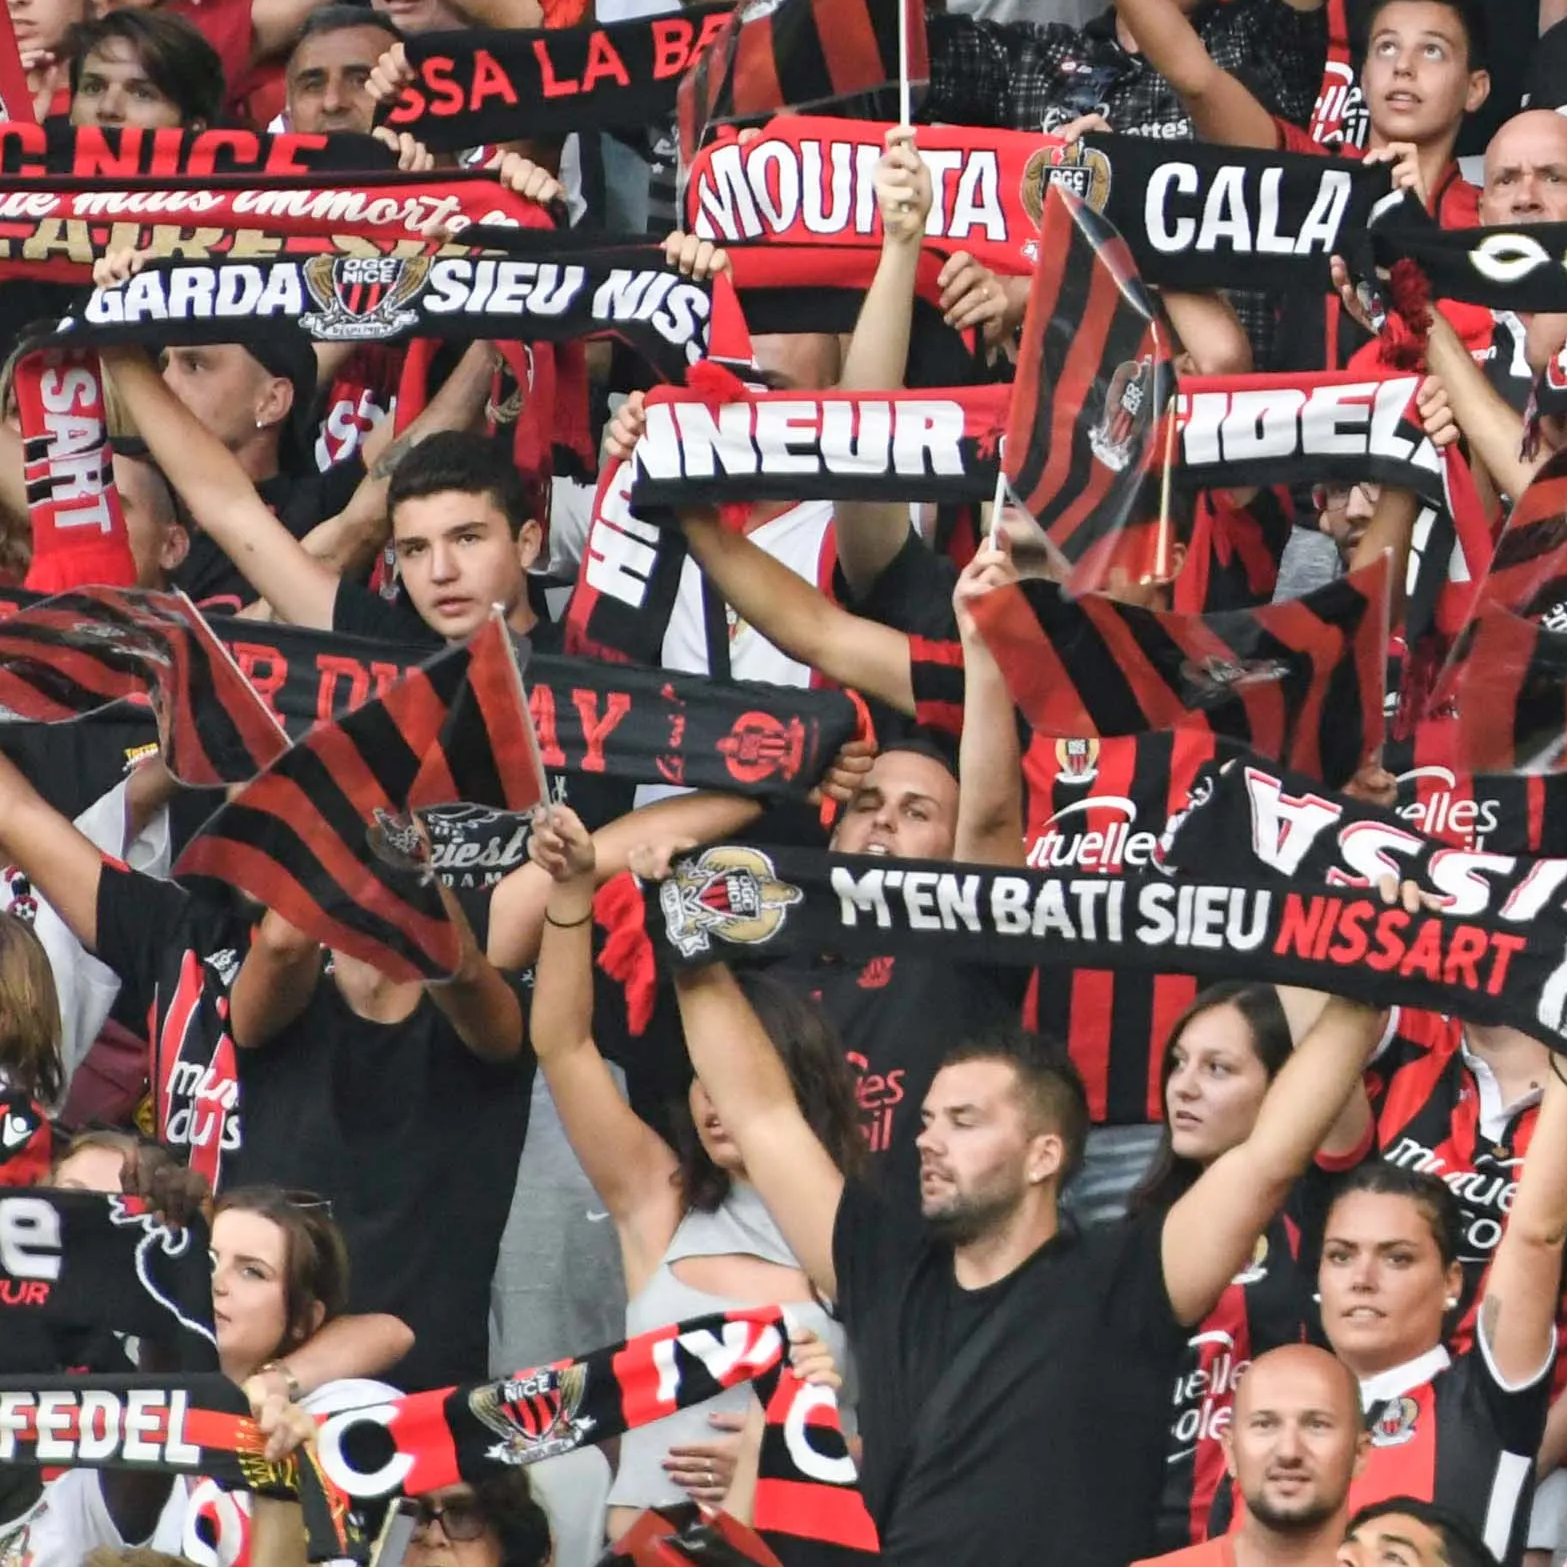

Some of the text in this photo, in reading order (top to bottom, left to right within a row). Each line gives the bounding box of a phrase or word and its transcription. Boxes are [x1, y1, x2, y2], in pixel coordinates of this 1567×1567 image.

[541, 31, 629, 99] LA
[1146, 162, 1352, 255] CALA
[85, 256, 584, 326] GARDA SIEU
[341, 269, 395, 284] NICE
[343, 258, 397, 271] OGC
[831, 866, 1527, 996] M'EN BATI SIEU NISSART
